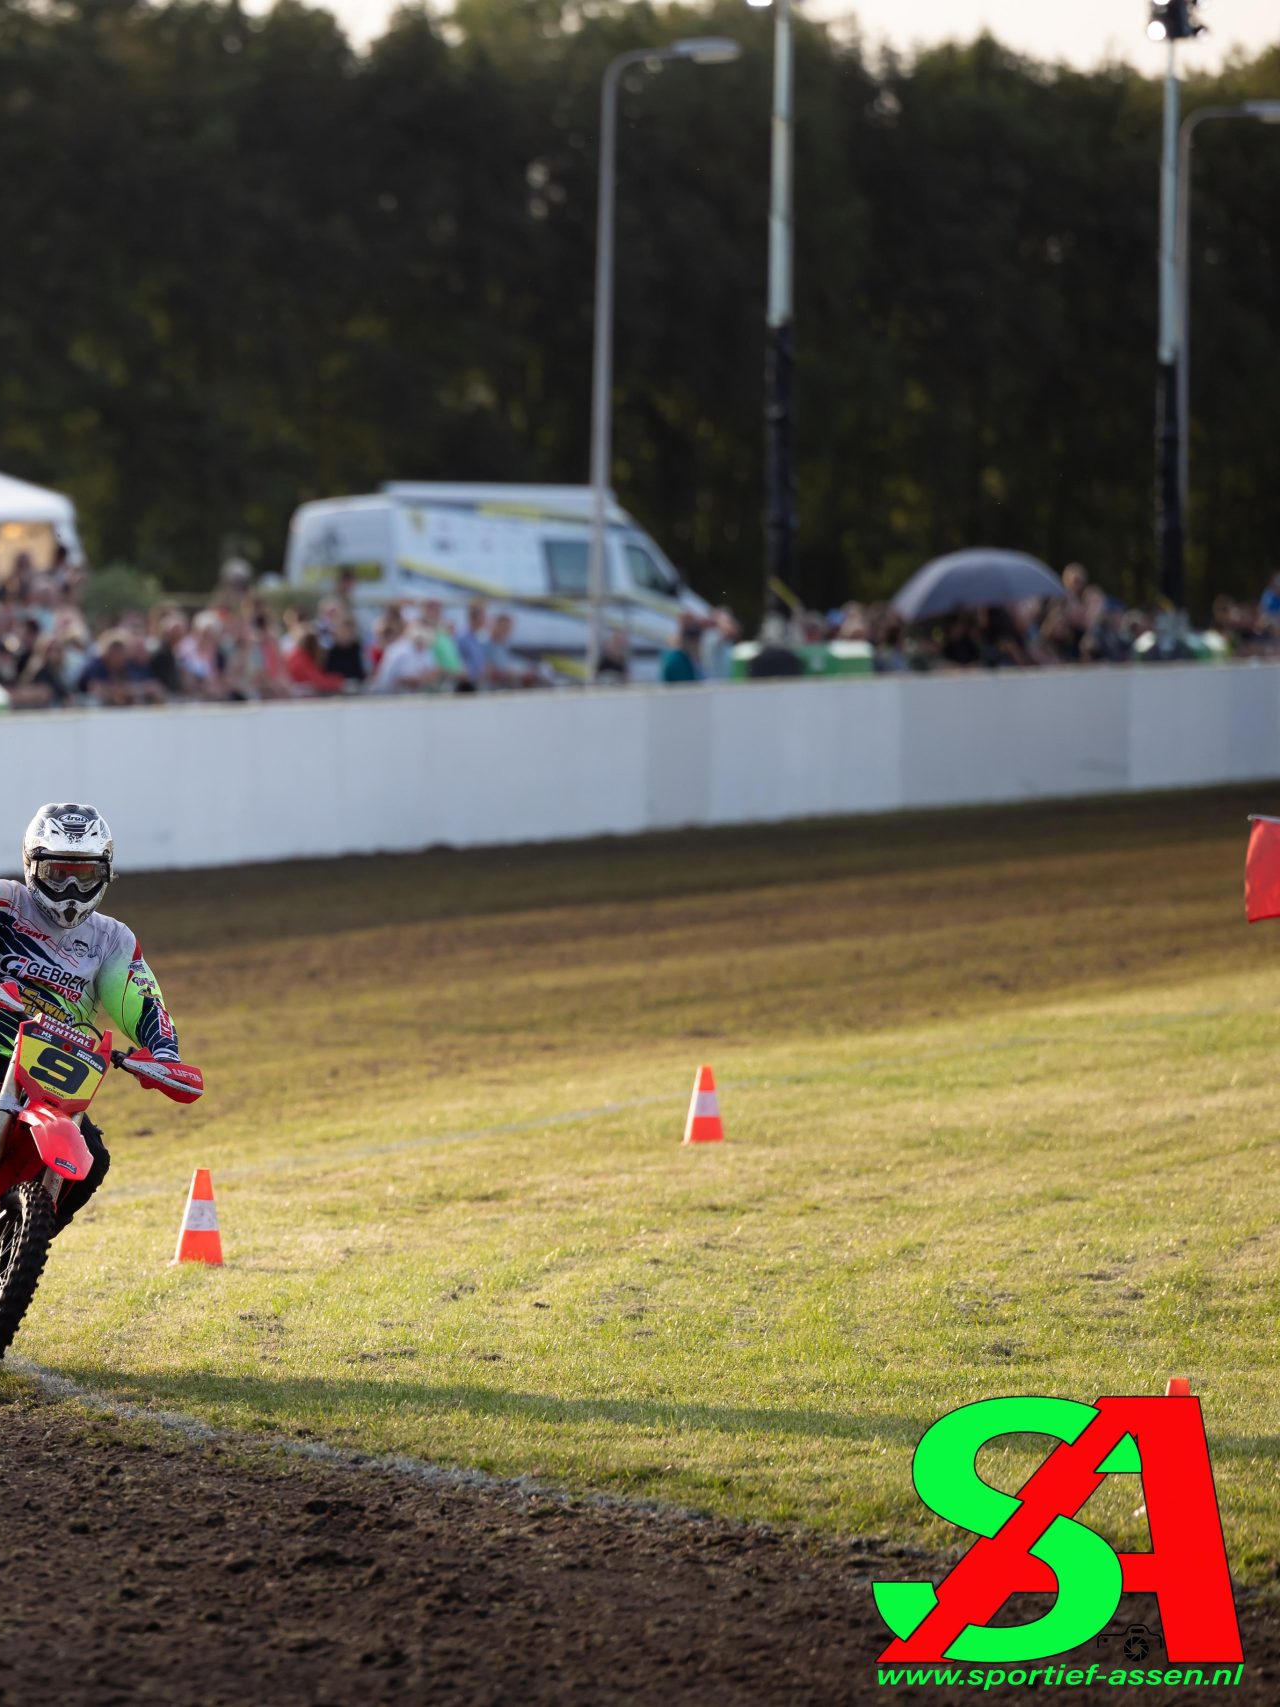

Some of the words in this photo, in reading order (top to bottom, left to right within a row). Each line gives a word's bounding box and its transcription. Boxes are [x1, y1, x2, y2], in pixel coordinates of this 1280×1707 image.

[12, 920, 51, 941] KENNY
[26, 962, 89, 992] GEBBEN
[42, 1021, 91, 1048] RENTHAL
[28, 1047, 90, 1095] 9
